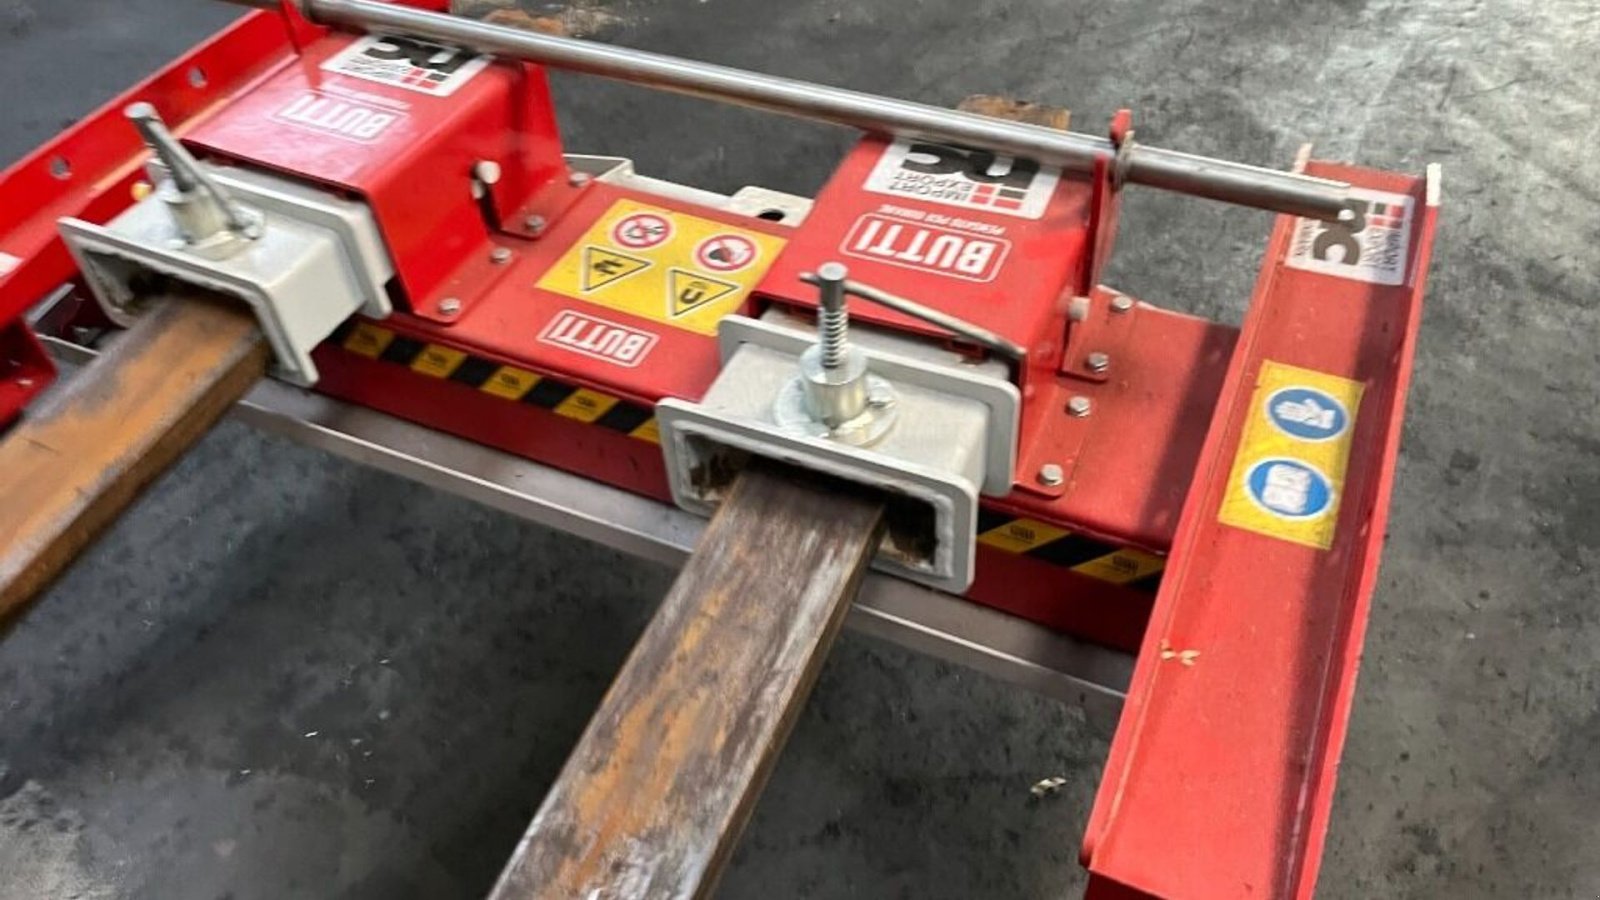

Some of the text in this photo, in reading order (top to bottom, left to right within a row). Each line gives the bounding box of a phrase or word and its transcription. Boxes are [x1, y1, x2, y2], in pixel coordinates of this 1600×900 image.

[279, 93, 398, 139] BUTTI
[889, 181, 969, 203] IMPORT
[893, 171, 974, 193] EXPORT
[853, 219, 998, 275] BUTTI
[548, 315, 650, 361] BUTTI
